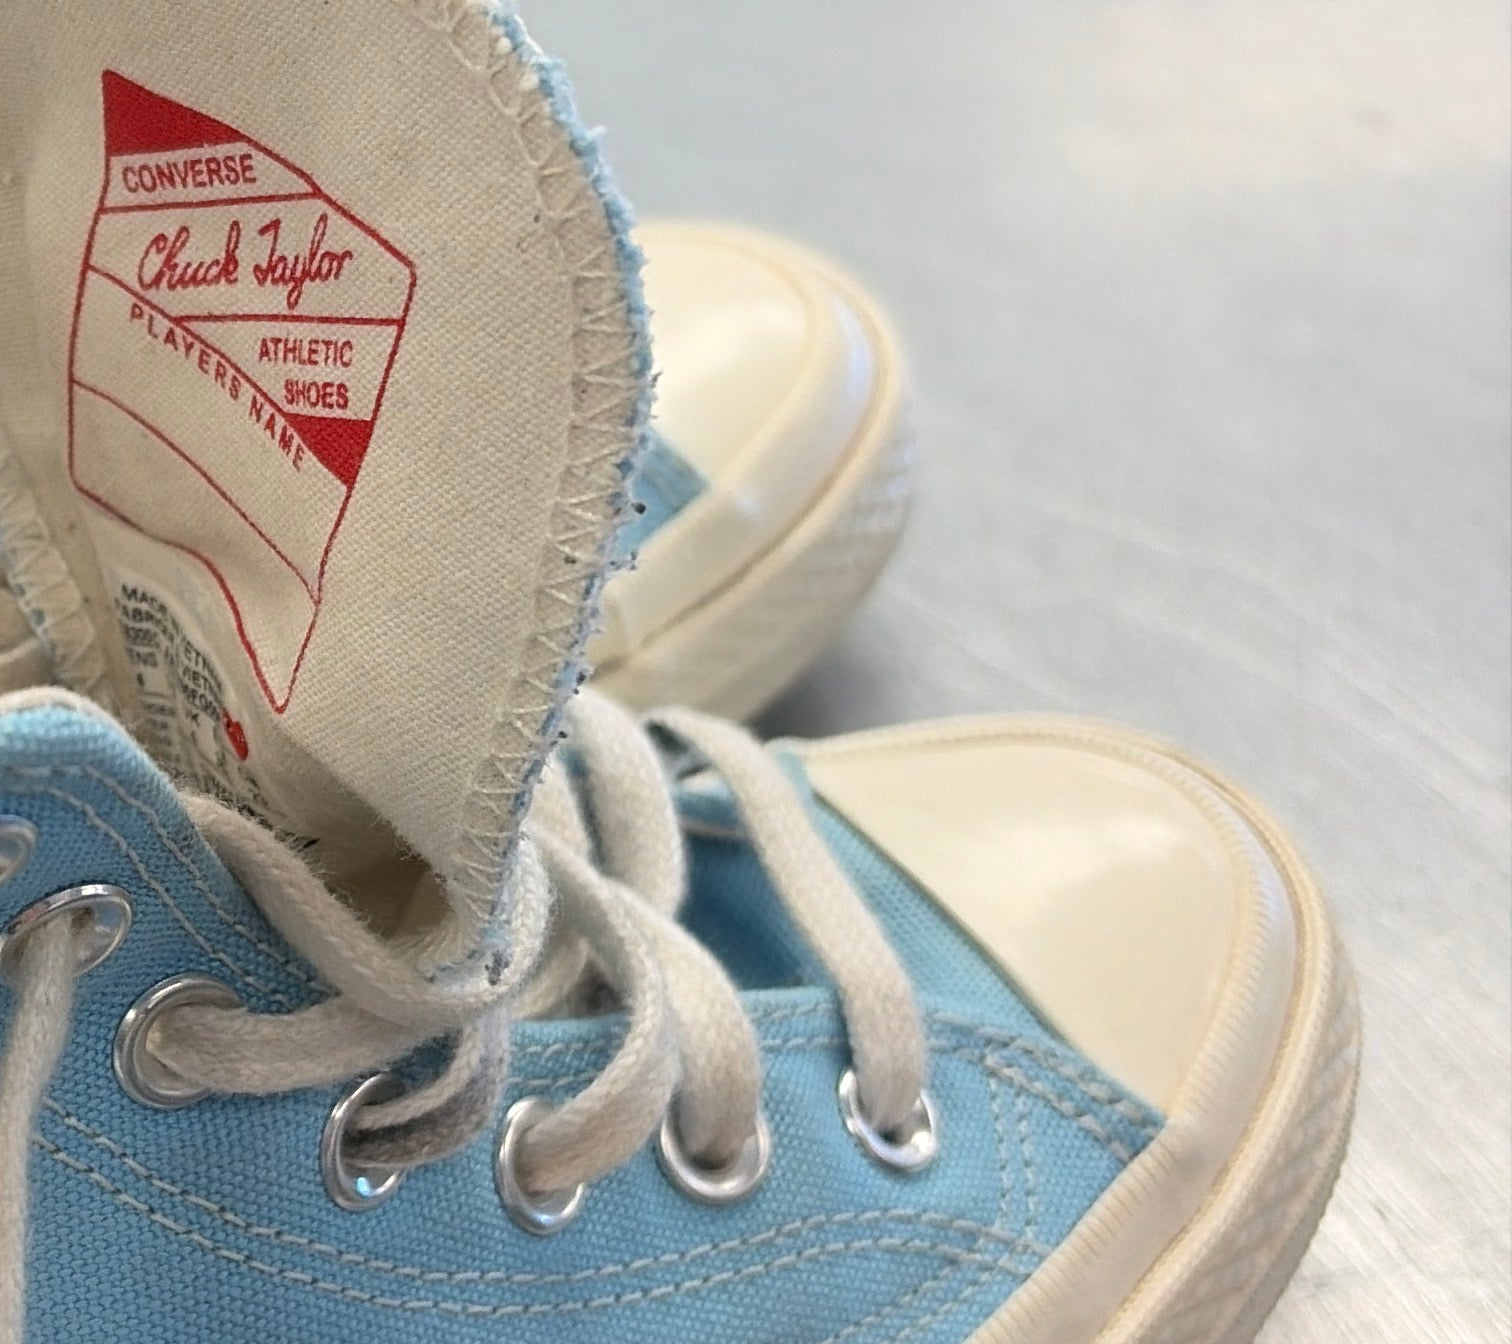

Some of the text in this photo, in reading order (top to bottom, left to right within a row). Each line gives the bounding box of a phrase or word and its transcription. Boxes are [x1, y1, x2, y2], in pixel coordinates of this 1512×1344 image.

[122, 154, 257, 194] CONVERSE
[138, 213, 354, 310] Chuck Taylor
[259, 337, 354, 369] ATHLETIC
[130, 303, 306, 472] PLAYERS NAME
[283, 378, 350, 411] SHOES
